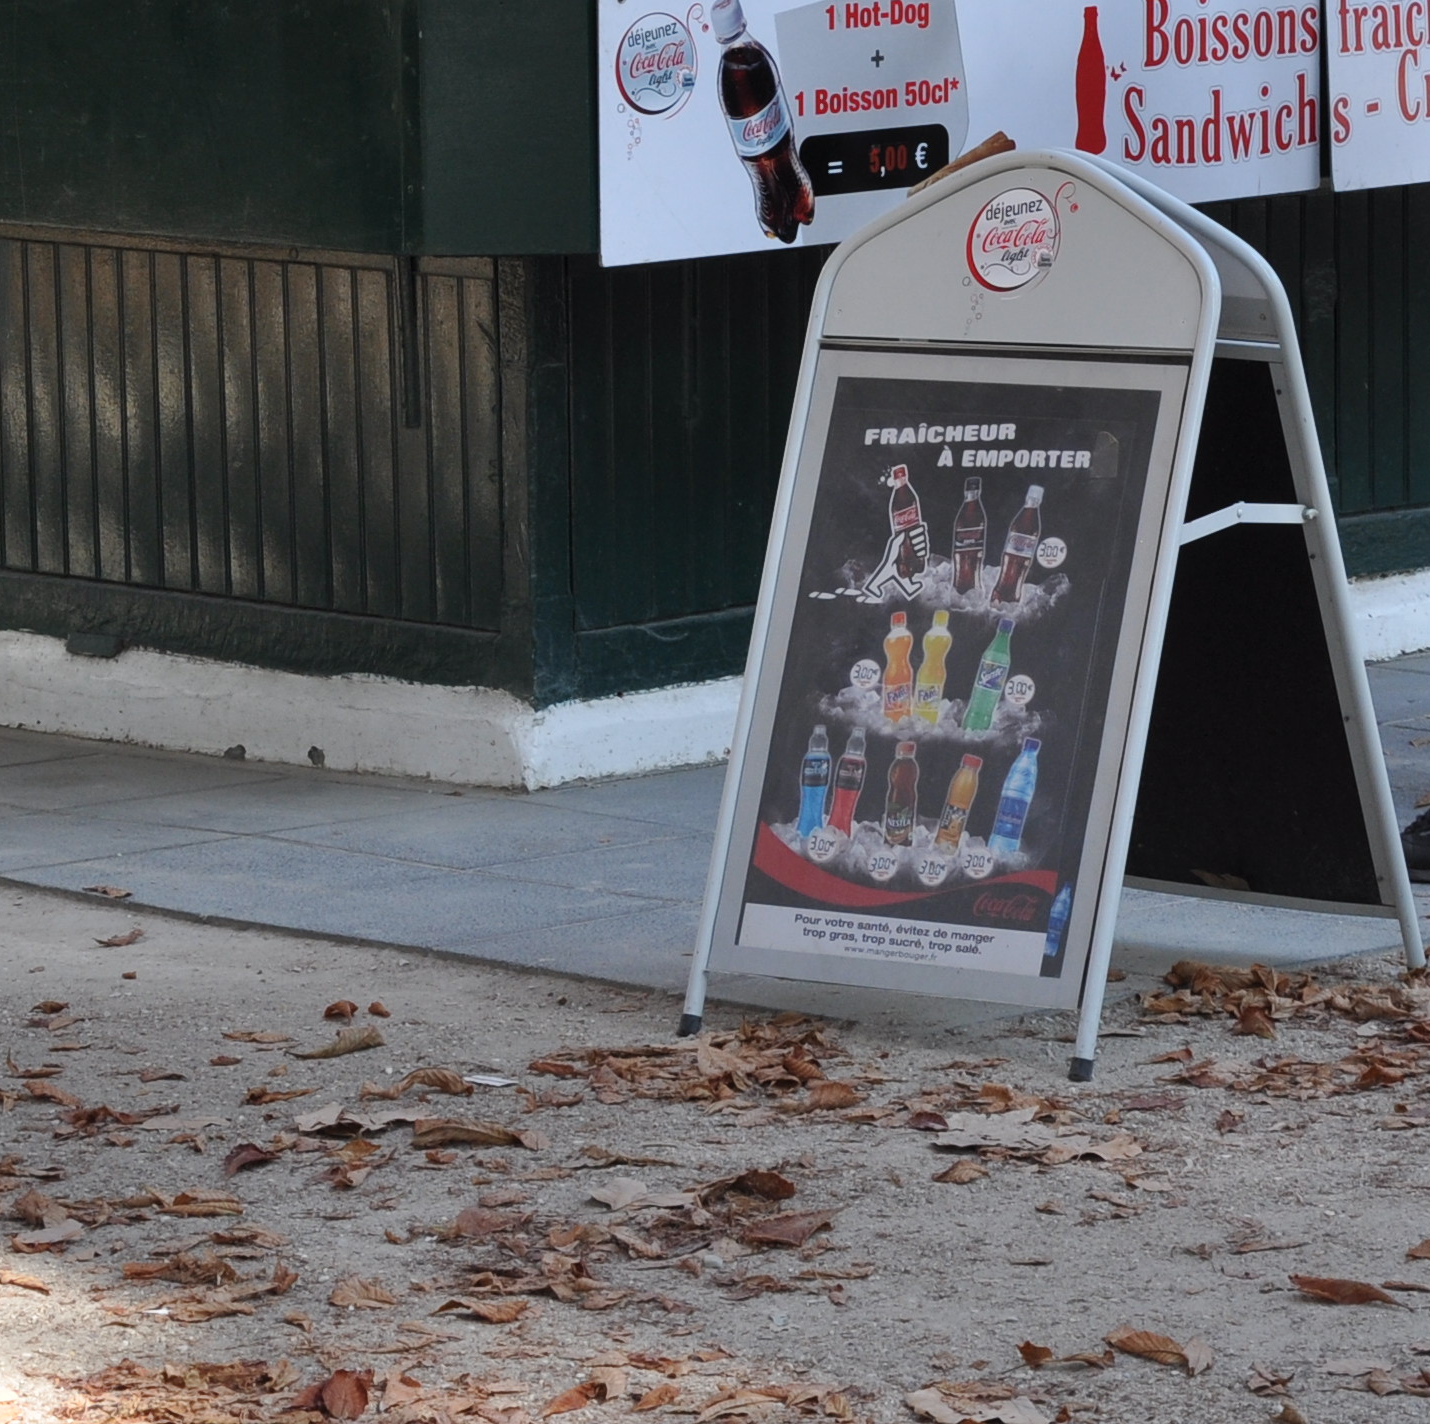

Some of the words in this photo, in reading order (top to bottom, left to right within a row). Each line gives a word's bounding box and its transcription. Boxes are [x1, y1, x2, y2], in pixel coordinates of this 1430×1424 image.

[826, 6, 834, 30] 1
[845, 1, 930, 30] Hot-Dog
[627, 22, 678, 48] déjeunez
[649, 72, 673, 87] light
[795, 92, 804, 116] 1
[815, 87, 897, 115] Boisson
[986, 200, 1043, 223] déjeunez
[1001, 247, 1029, 265] light
[865, 423, 1016, 445] FRAÎCHEUR
[938, 446, 953, 467] À
[962, 450, 1091, 468] EMPORTER
[795, 914, 822, 924] Pour
[825, 918, 854, 928] votre
[857, 920, 892, 934] santé,
[896, 924, 929, 936] évitez
[933, 928, 947, 938] de
[951, 931, 995, 944] manger
[803, 927, 825, 940] trop
[829, 932, 858, 943] gras,
[861, 934, 885, 946] trop
[889, 936, 925, 949] sucré,
[929, 940, 951, 953] trop
[955, 942, 981, 954] salé.
[843, 946, 938, 961] www.mangerbouger.fr
